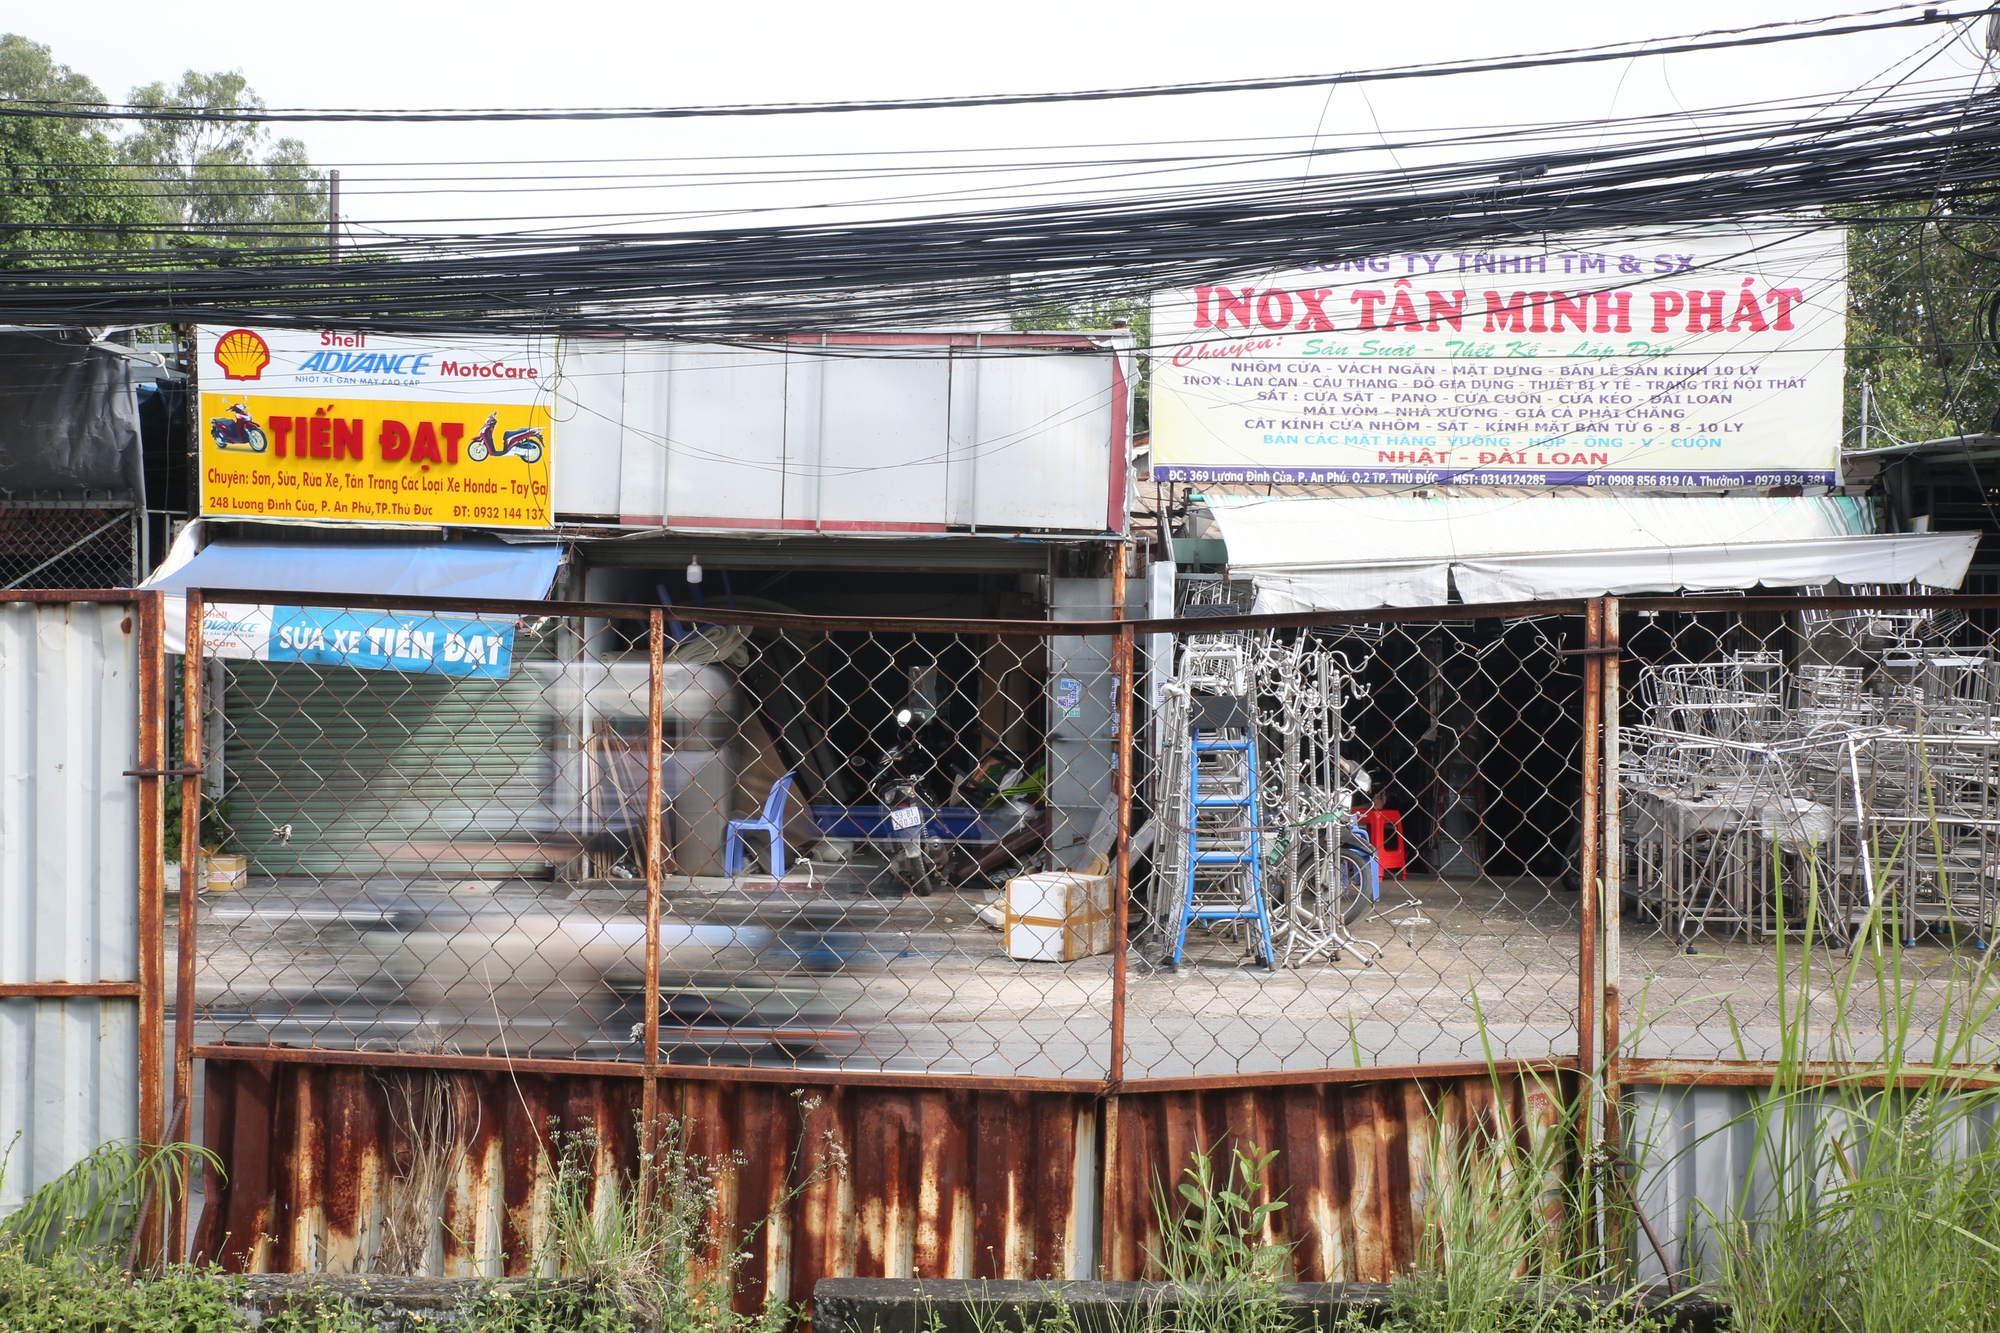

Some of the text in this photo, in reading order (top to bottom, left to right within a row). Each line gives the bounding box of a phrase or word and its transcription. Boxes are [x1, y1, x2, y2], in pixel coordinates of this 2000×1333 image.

[1401, 253, 1697, 274] TY TNHH TM & SX
[1193, 277, 1803, 333] INOX TÂN MINH PHÁT
[320, 329, 367, 348] Shell
[1302, 338, 1349, 356] Sản
[1505, 341, 1541, 358] Kế
[297, 350, 434, 375] ADVANCE
[440, 361, 539, 379] MotoCare
[1231, 360, 1281, 373] NHÔM
[1286, 361, 1321, 374] CỬA
[1337, 362, 1382, 374] VÁCH
[1388, 363, 1435, 375] NGĂN
[1453, 364, 1488, 378] MẶT
[1664, 364, 1707, 376] KÍNH
[1714, 366, 1734, 376] 10
[1740, 366, 1759, 376] LY
[323, 376, 333, 384] XE
[382, 378, 400, 386] CAO
[1183, 375, 1221, 385] INOX
[1235, 377, 1265, 387] LAN
[1268, 377, 1298, 388] CAN
[1313, 376, 1342, 388] CẦU
[1349, 378, 1398, 389] THANG
[1413, 376, 1434, 389] ĐỒ
[1439, 380, 1466, 389] GIA
[1471, 380, 1514, 391] DỤNG
[1529, 378, 1573, 390] THIẾT
[1600, 380, 1608, 390] Y
[1646, 380, 1697, 390] TRANG
[1702, 378, 1728, 390] TRÍ
[1733, 379, 1762, 392] NỘI
[1767, 378, 1807, 389] THẤT
[1304, 390, 1339, 402] CỬA
[1391, 393, 1437, 403] PANO
[1454, 392, 1488, 404] CỬA
[1559, 392, 1593, 404] CỬA
[1599, 392, 1632, 404] KÉO
[1650, 393, 1681, 404] ĐÀI
[1687, 395, 1732, 404] LOAN
[1303, 403, 1335, 416] MÁI
[1341, 404, 1378, 416] VÒM
[1396, 405, 1431, 417] NHÀ
[1436, 405, 1498, 418] XƯỞNG
[1515, 406, 1546, 418] GIÁ
[1551, 406, 1573, 418] CẢ
[1626, 406, 1685, 419] CHĂNG
[1281, 417, 1324, 430] KÍNH
[1329, 418, 1363, 430] CỬA
[1369, 418, 1420, 431] NHÔM
[1486, 420, 1529, 432] KÍNH
[1535, 420, 1570, 434] MẶT
[1575, 420, 1609, 433] BÀN
[1615, 420, 1639, 433] TỪ
[1643, 422, 1653, 433] 6
[1670, 422, 1680, 433] 8
[1699, 422, 1718, 433] 10
[1724, 422, 1744, 433] LY
[269, 405, 465, 472] TIẾN ĐẠT
[1263, 432, 1299, 445] BÁN
[1304, 433, 1339, 445] CÁC
[1344, 432, 1381, 447] MẶT
[1387, 433, 1437, 446] HÀNG
[1447, 434, 1511, 447] VUÔNG
[1529, 434, 1566, 450] HỘP
[1642, 438, 1653, 448] V
[1671, 435, 1722, 450] CUỘN
[1378, 447, 1608, 467] NHẬT ĐÀI LOAN
[208, 468, 249, 489] Chuyên:
[325, 472, 343, 492] Xe,
[345, 473, 364, 489] Tân
[368, 474, 398, 494] Trang
[401, 475, 419, 491] Các
[422, 476, 443, 495] Loại
[446, 477, 461, 492] Xe
[464, 478, 498, 494] Honda
[510, 479, 529, 499] Tay
[532, 480, 546, 496] Ga
[1168, 470, 1187, 481] ĐC:
[1189, 470, 1209, 481] 369
[1246, 470, 1270, 482] Đình
[1298, 471, 1308, 483] P.
[1310, 472, 1324, 483] An
[1391, 470, 1413, 484] THỦ
[1415, 470, 1438, 484] ĐỨC
[1453, 473, 1478, 485] MST:
[1481, 474, 1546, 485] 0314124285
[1587, 475, 1605, 486] ĐT:
[1607, 475, 1634, 486] 0908
[1637, 475, 1656, 486] 856
[1659, 475, 1679, 486] 819
[1755, 475, 1781, 486] 0979
[1784, 475, 1804, 485] 934
[209, 496, 229, 509] 248
[267, 498, 292, 511] Đình
[295, 499, 318, 514] Của,
[321, 500, 331, 512] P.
[333, 501, 348, 513] An
[414, 503, 433, 516] Đức
[453, 506, 470, 518] ĐT:
[474, 506, 499, 519] 0932
[503, 507, 522, 520] 144
[525, 509, 544, 520] 137
[279, 620, 504, 670] SỬA XE TIẾN ĐẠT
